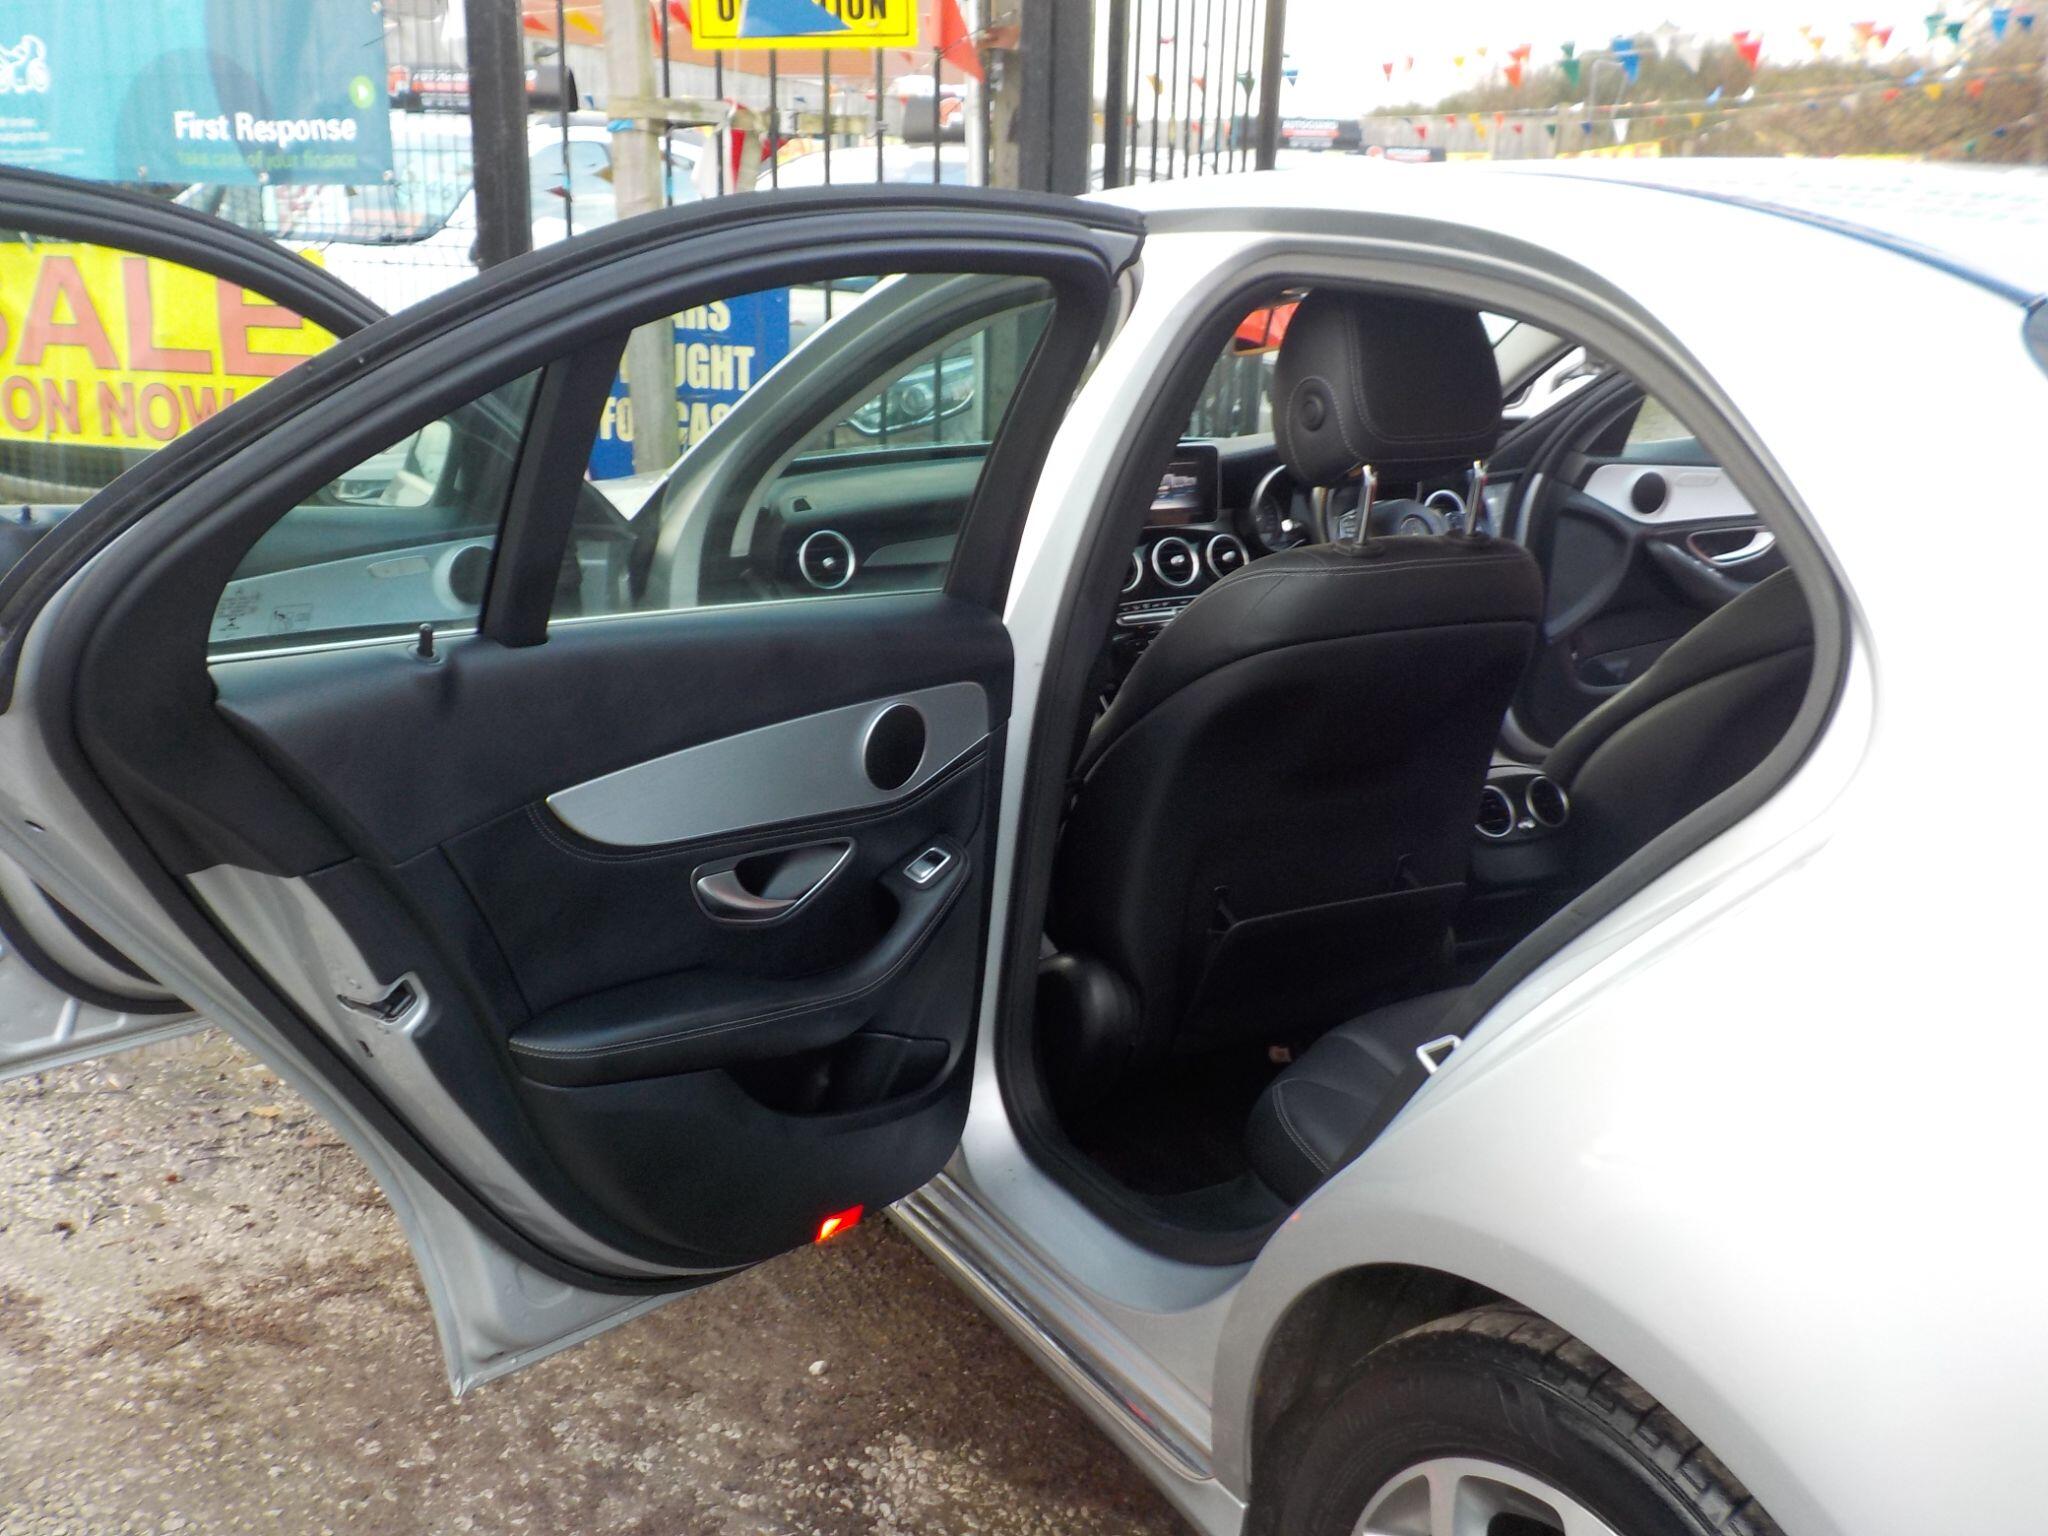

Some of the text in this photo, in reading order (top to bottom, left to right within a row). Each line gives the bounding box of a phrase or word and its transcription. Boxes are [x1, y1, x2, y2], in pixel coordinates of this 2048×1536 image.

[174, 110, 357, 149] First Response
[0, 255, 312, 377] ALE
[3, 375, 81, 433] ON
[600, 396, 634, 442] FO
